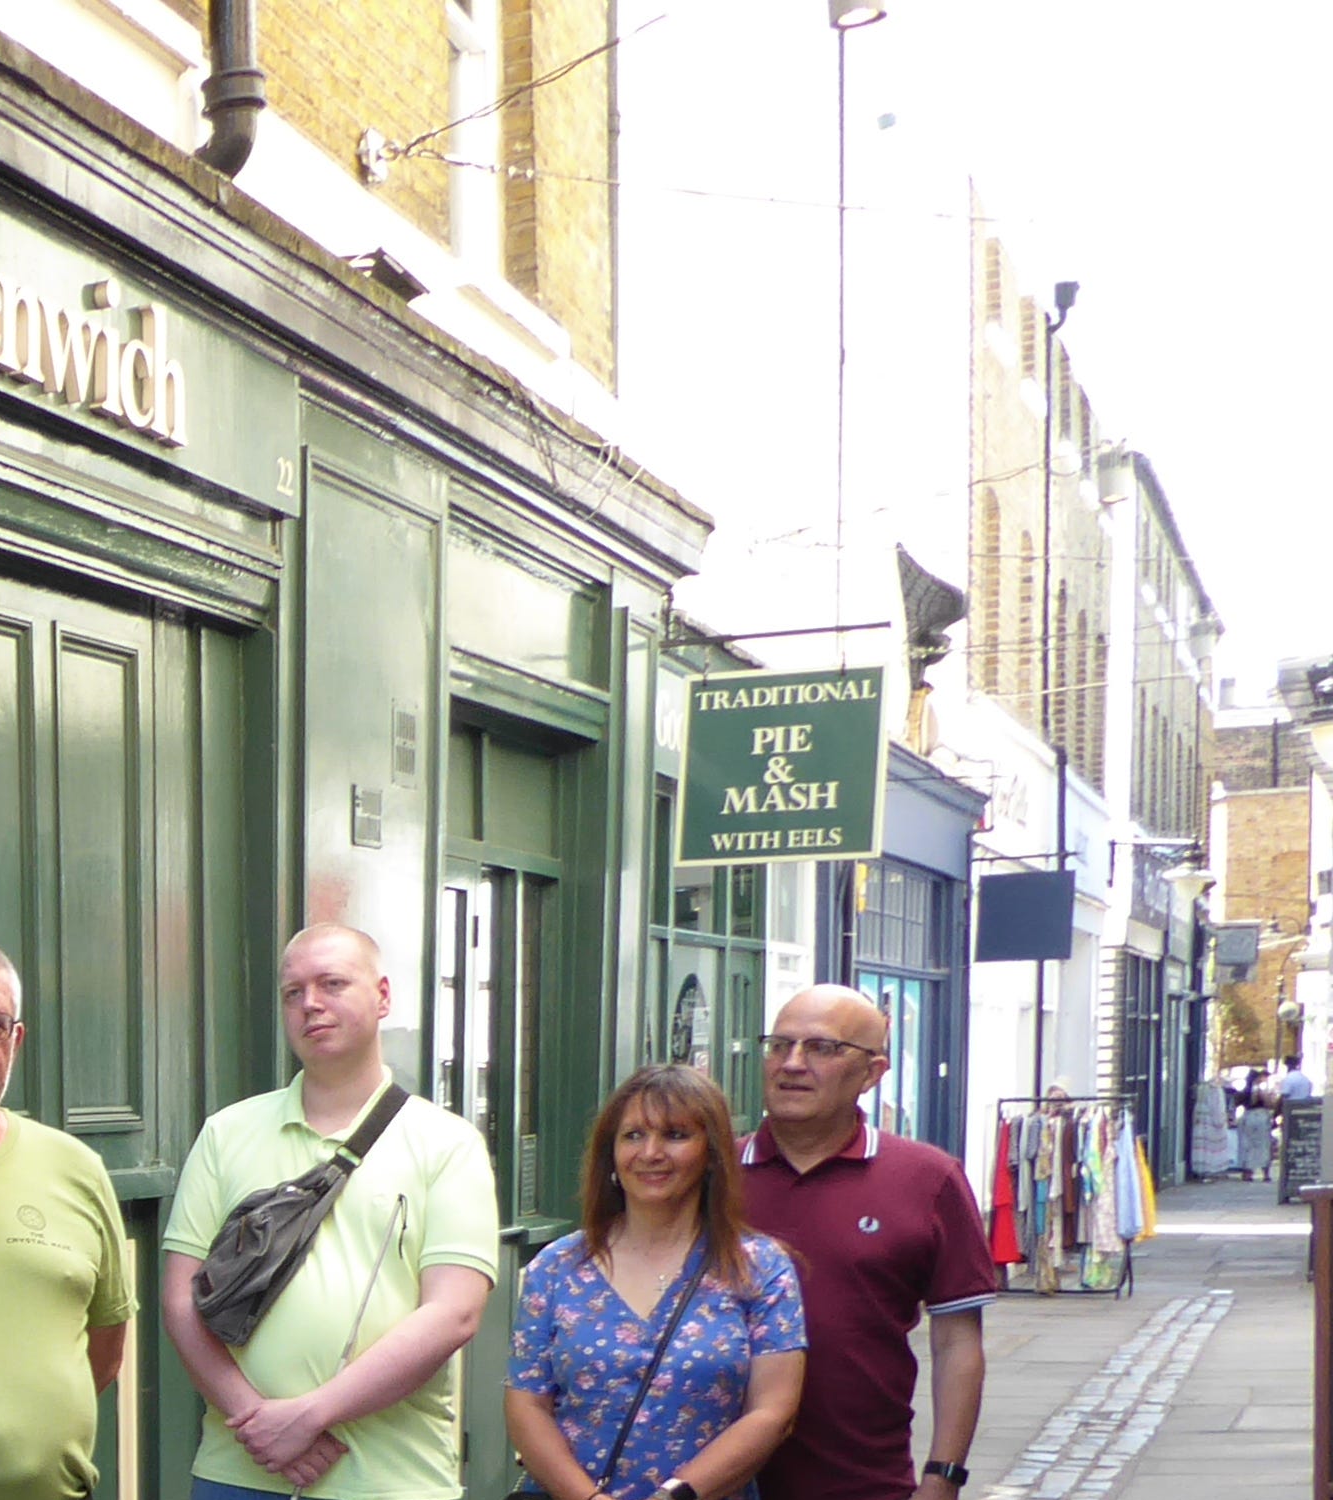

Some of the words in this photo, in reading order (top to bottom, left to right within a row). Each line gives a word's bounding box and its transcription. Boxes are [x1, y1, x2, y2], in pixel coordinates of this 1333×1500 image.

[276, 456, 294, 497] 22
[695, 679, 878, 711] TRADITIONAL
[750, 724, 814, 756] PIE
[763, 756, 796, 784] &
[719, 781, 840, 816] MASH
[710, 831, 781, 852] WITH
[786, 827, 843, 849] EELS
